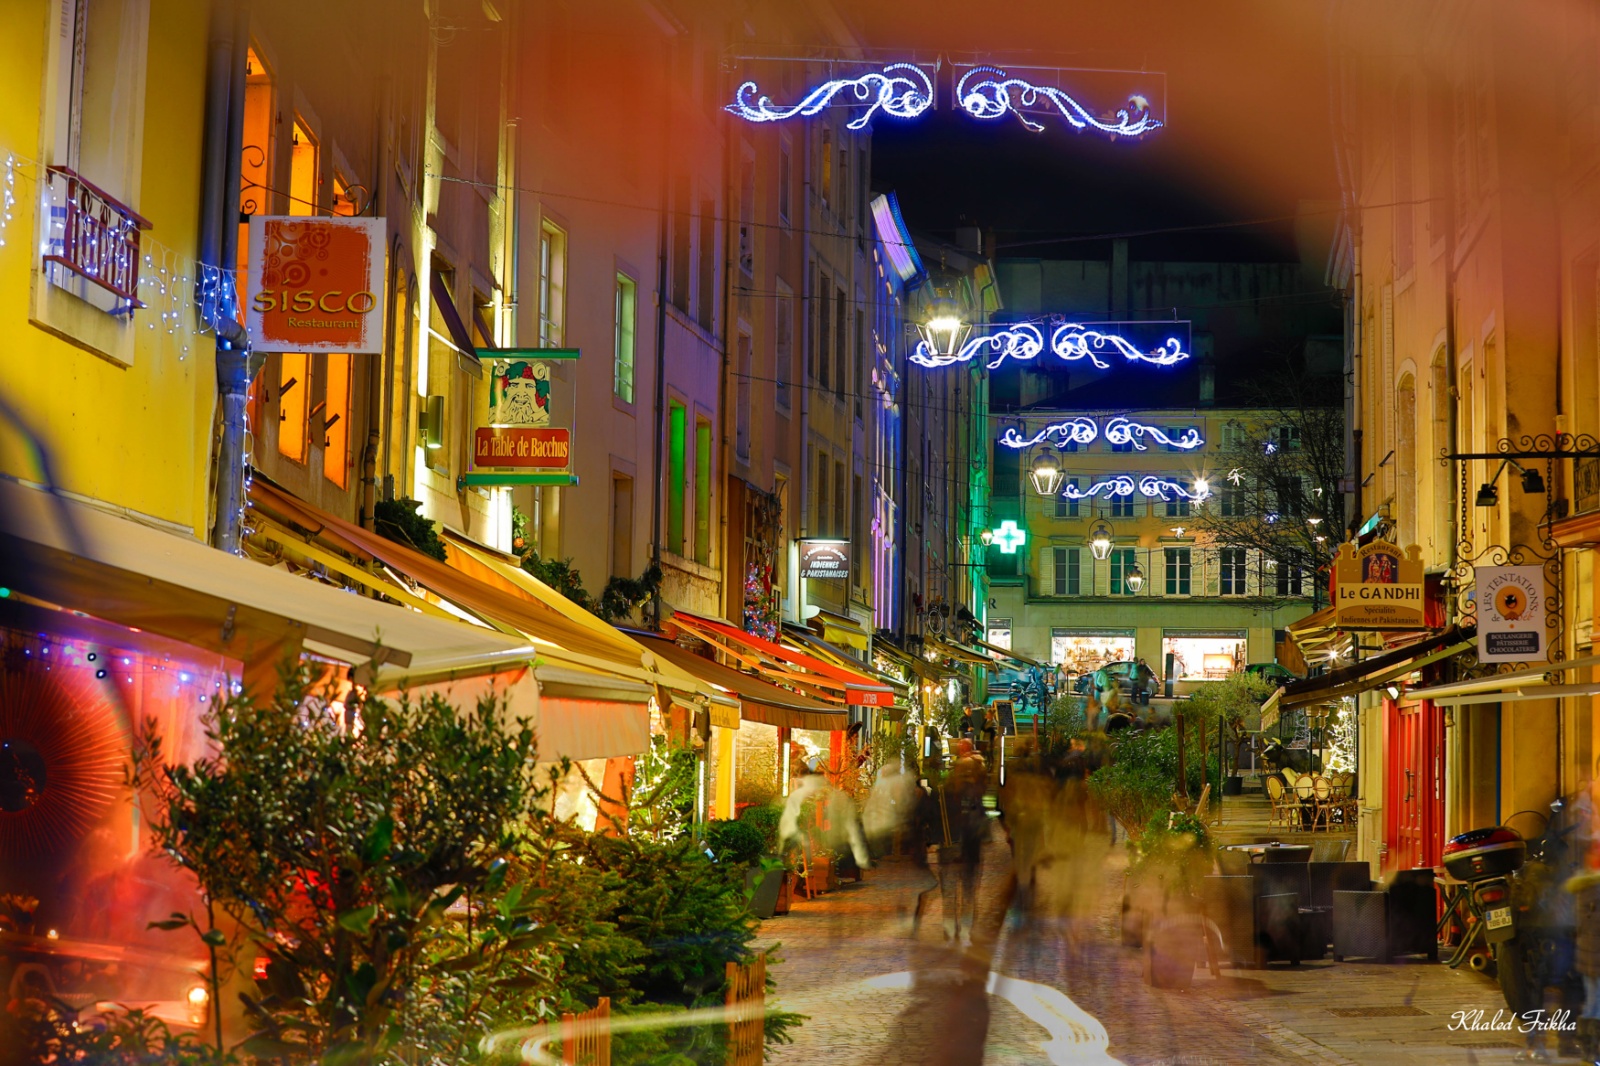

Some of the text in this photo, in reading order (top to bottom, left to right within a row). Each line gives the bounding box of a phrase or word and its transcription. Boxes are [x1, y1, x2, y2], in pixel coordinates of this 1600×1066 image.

[288, 317, 360, 329] Restaurant
[477, 435, 568, 458] La Table de Bacchus
[1360, 543, 1402, 558] Restaurant
[810, 561, 839, 569] INDIENNES
[1340, 587, 1420, 600] Le GANDHI
[1483, 573, 1540, 612] LES TENTATIONS
[1341, 616, 1370, 624] Indiennes
[1379, 616, 1419, 624] Pakistanaises
[1491, 614, 1500, 622] de
